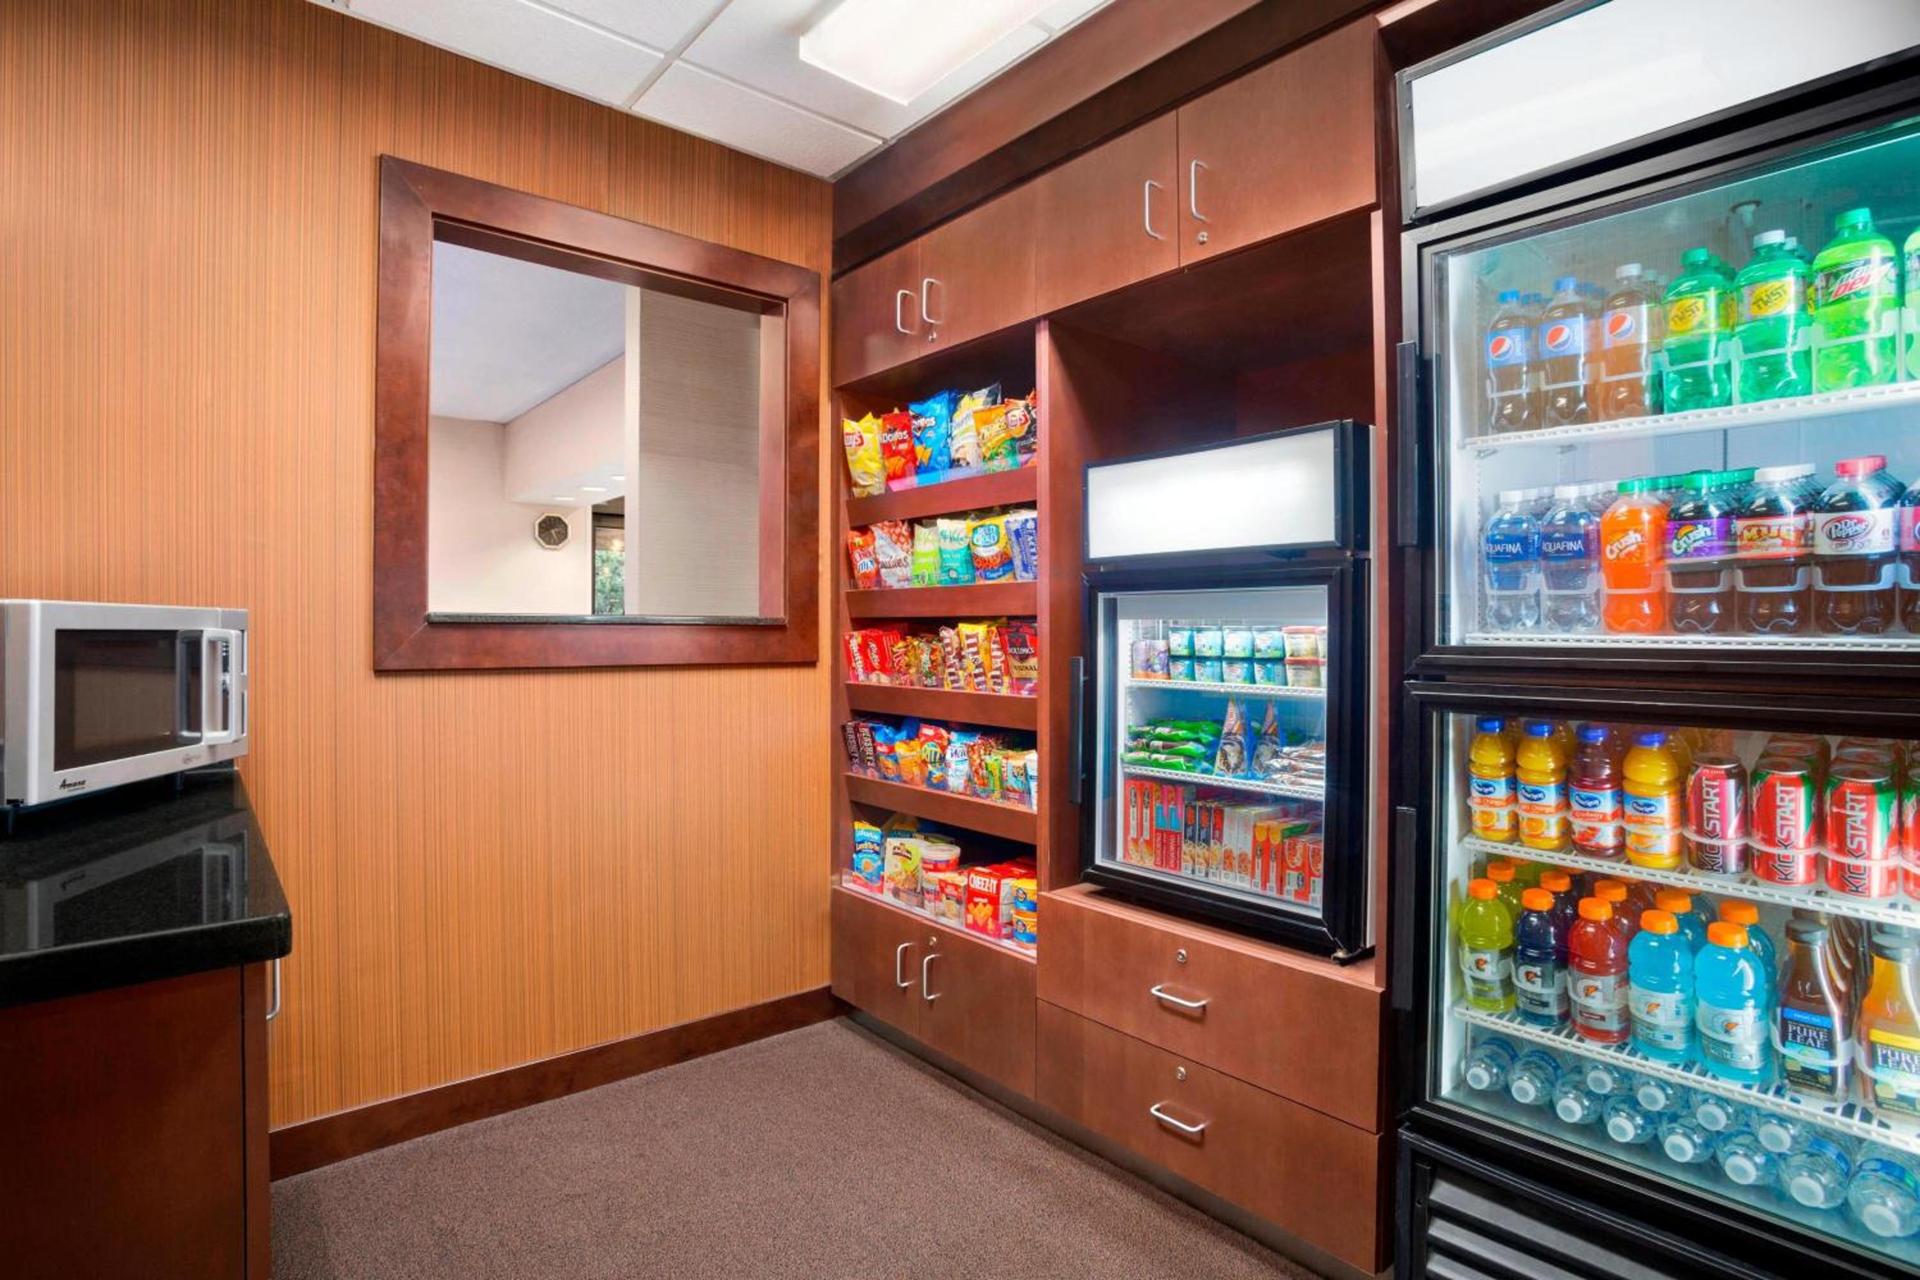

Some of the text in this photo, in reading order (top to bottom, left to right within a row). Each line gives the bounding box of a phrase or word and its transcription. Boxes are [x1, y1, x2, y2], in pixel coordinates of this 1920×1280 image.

[1672, 524, 1713, 556] Crush
[1517, 965, 1543, 991] G
[1577, 978, 1602, 1004] G
[1787, 1021, 1828, 1041] PURE
[1787, 1031, 1826, 1049] LEAF
